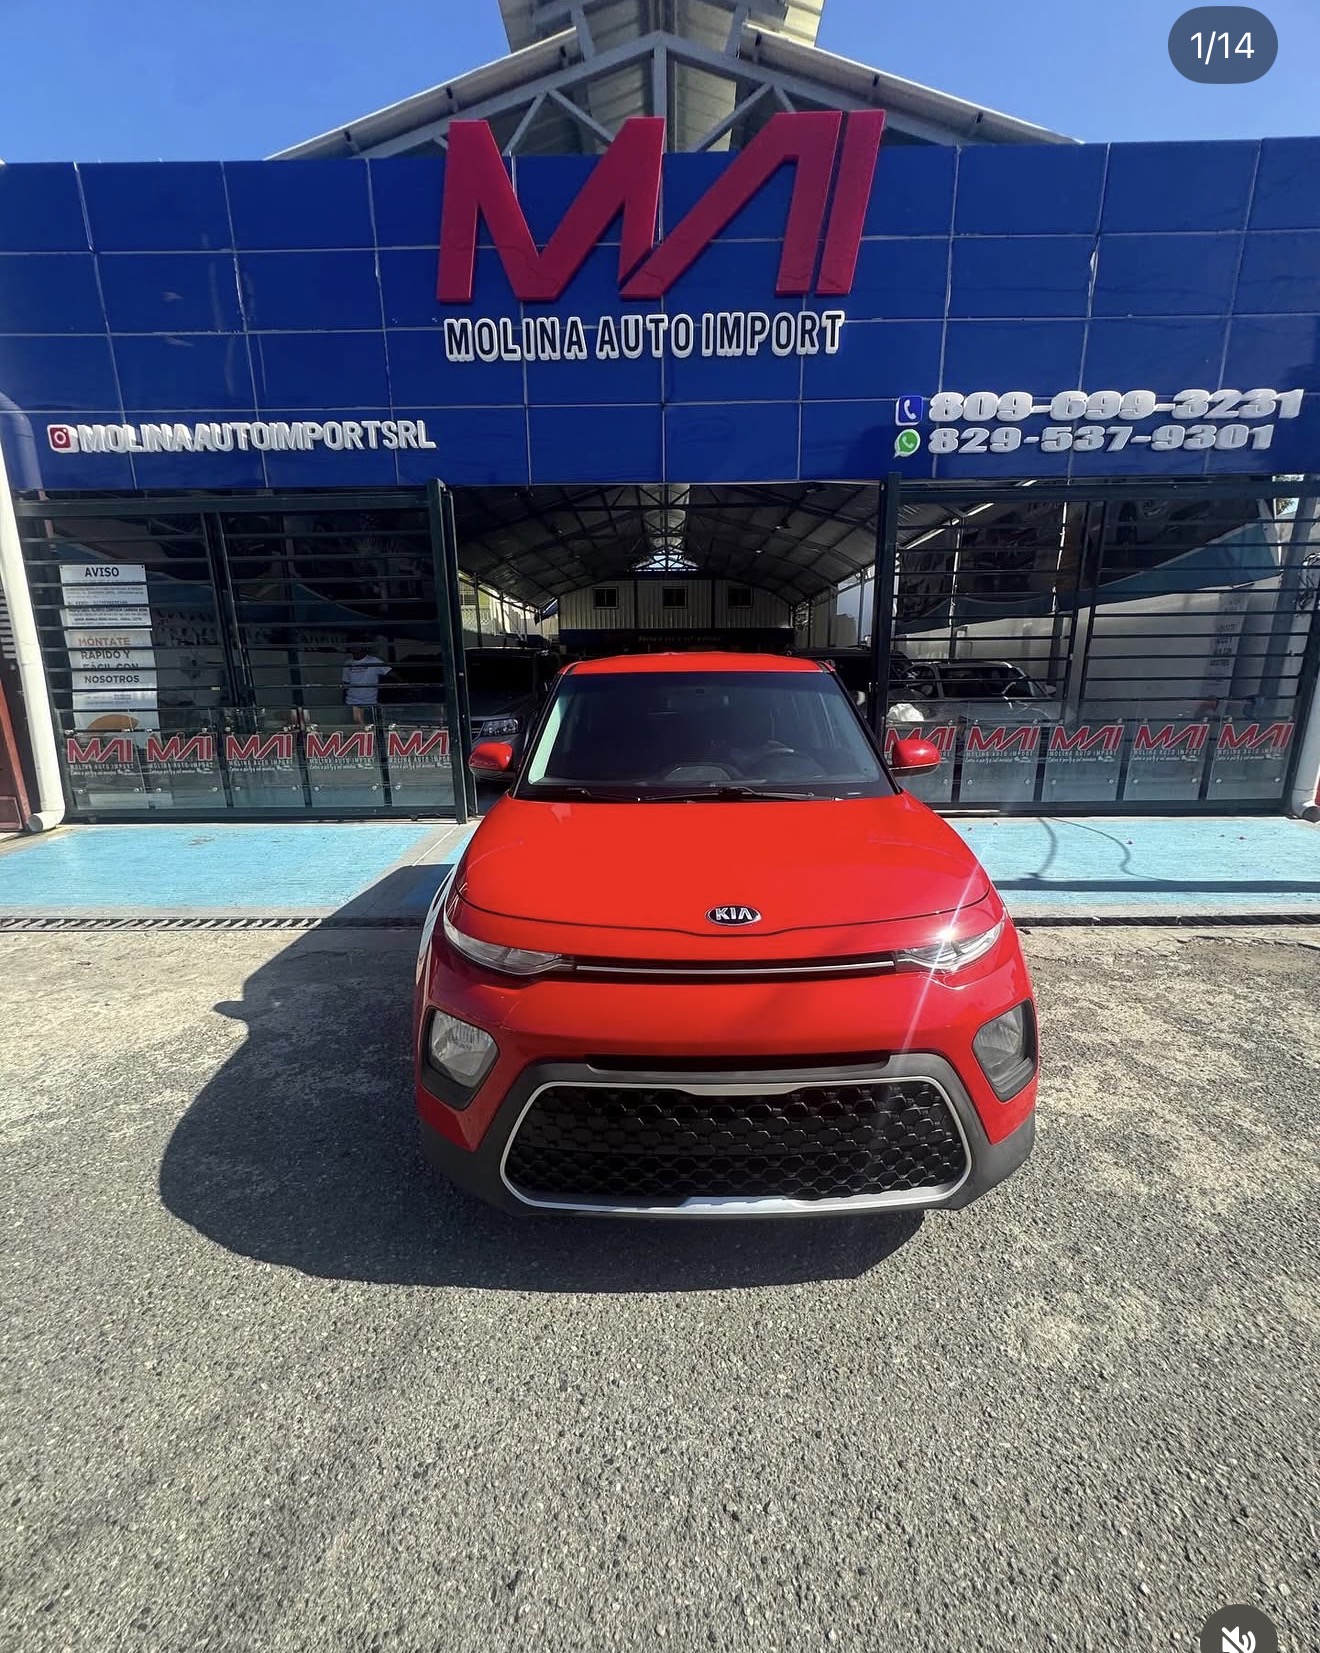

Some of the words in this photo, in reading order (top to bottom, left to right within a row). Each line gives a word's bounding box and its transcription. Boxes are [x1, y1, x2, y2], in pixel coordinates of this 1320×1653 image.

[437, 109, 886, 303] MAI
[443, 316, 588, 362] MOLINA
[595, 314, 694, 360] AUTO
[700, 311, 846, 357] IMPORT
[928, 389, 1305, 422] 809-699-3231
[77, 420, 437, 453] MOLINAAUTOIMPORTSRL
[928, 424, 1275, 454] 829-537-9301
[84, 566, 120, 578] AVISO
[123, 650, 131, 660] Y
[84, 675, 140, 684] NOSOTROS
[146, 737, 213, 761] MAI
[226, 735, 293, 760] MAI
[306, 732, 375, 758] MAI
[966, 727, 1040, 752] MAI
[1049, 726, 1125, 751] MAI
[1133, 725, 1210, 750] MAI
[1217, 724, 1295, 749] MAI
[66, 738, 134, 763] MAI
[715, 907, 753, 921] KIA
